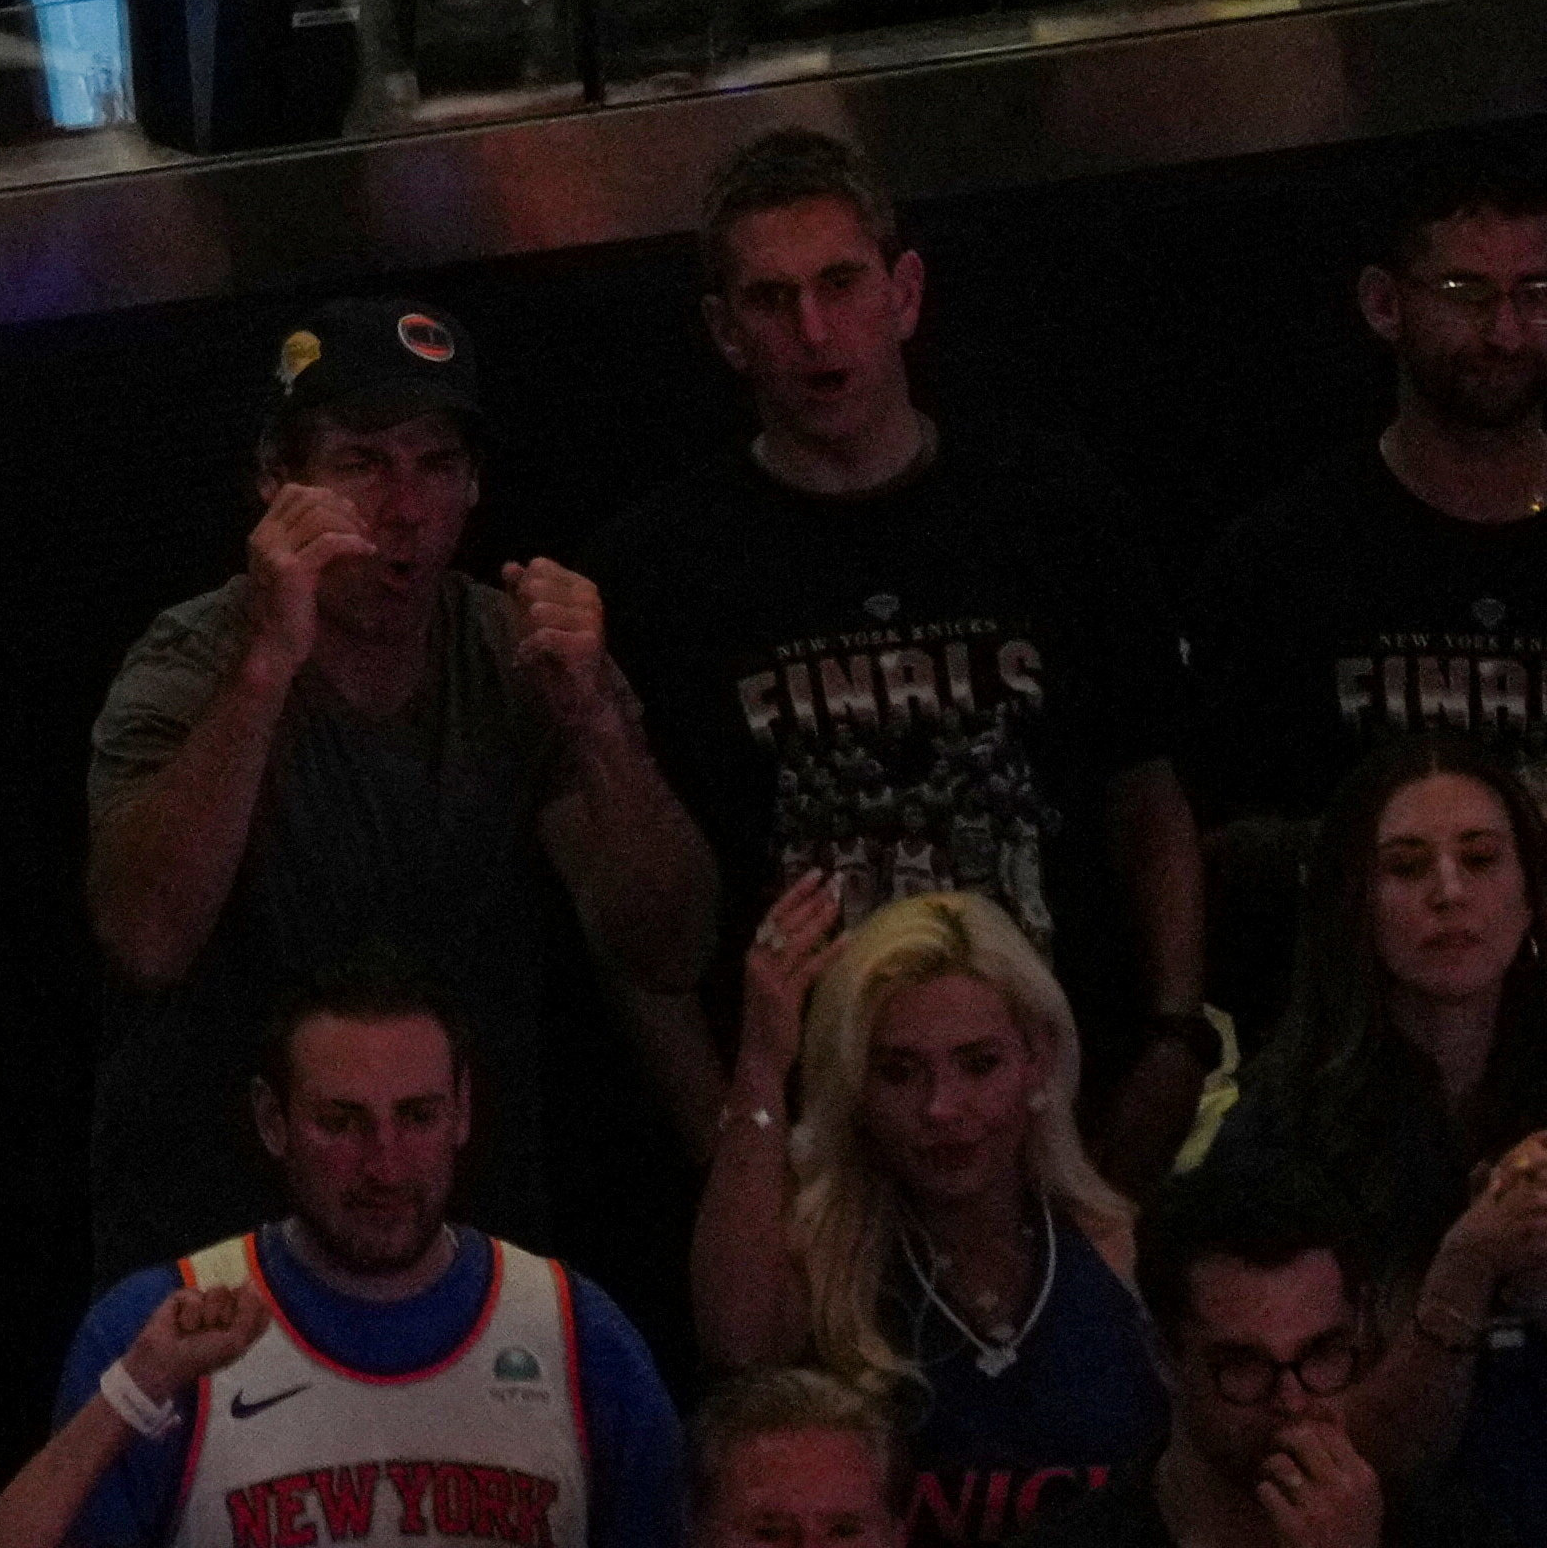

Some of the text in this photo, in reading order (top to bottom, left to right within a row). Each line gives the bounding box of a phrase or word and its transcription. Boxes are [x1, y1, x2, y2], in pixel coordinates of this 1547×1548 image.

[736, 639, 1045, 746] FINALS
[225, 1457, 560, 1548] NEW YORK
